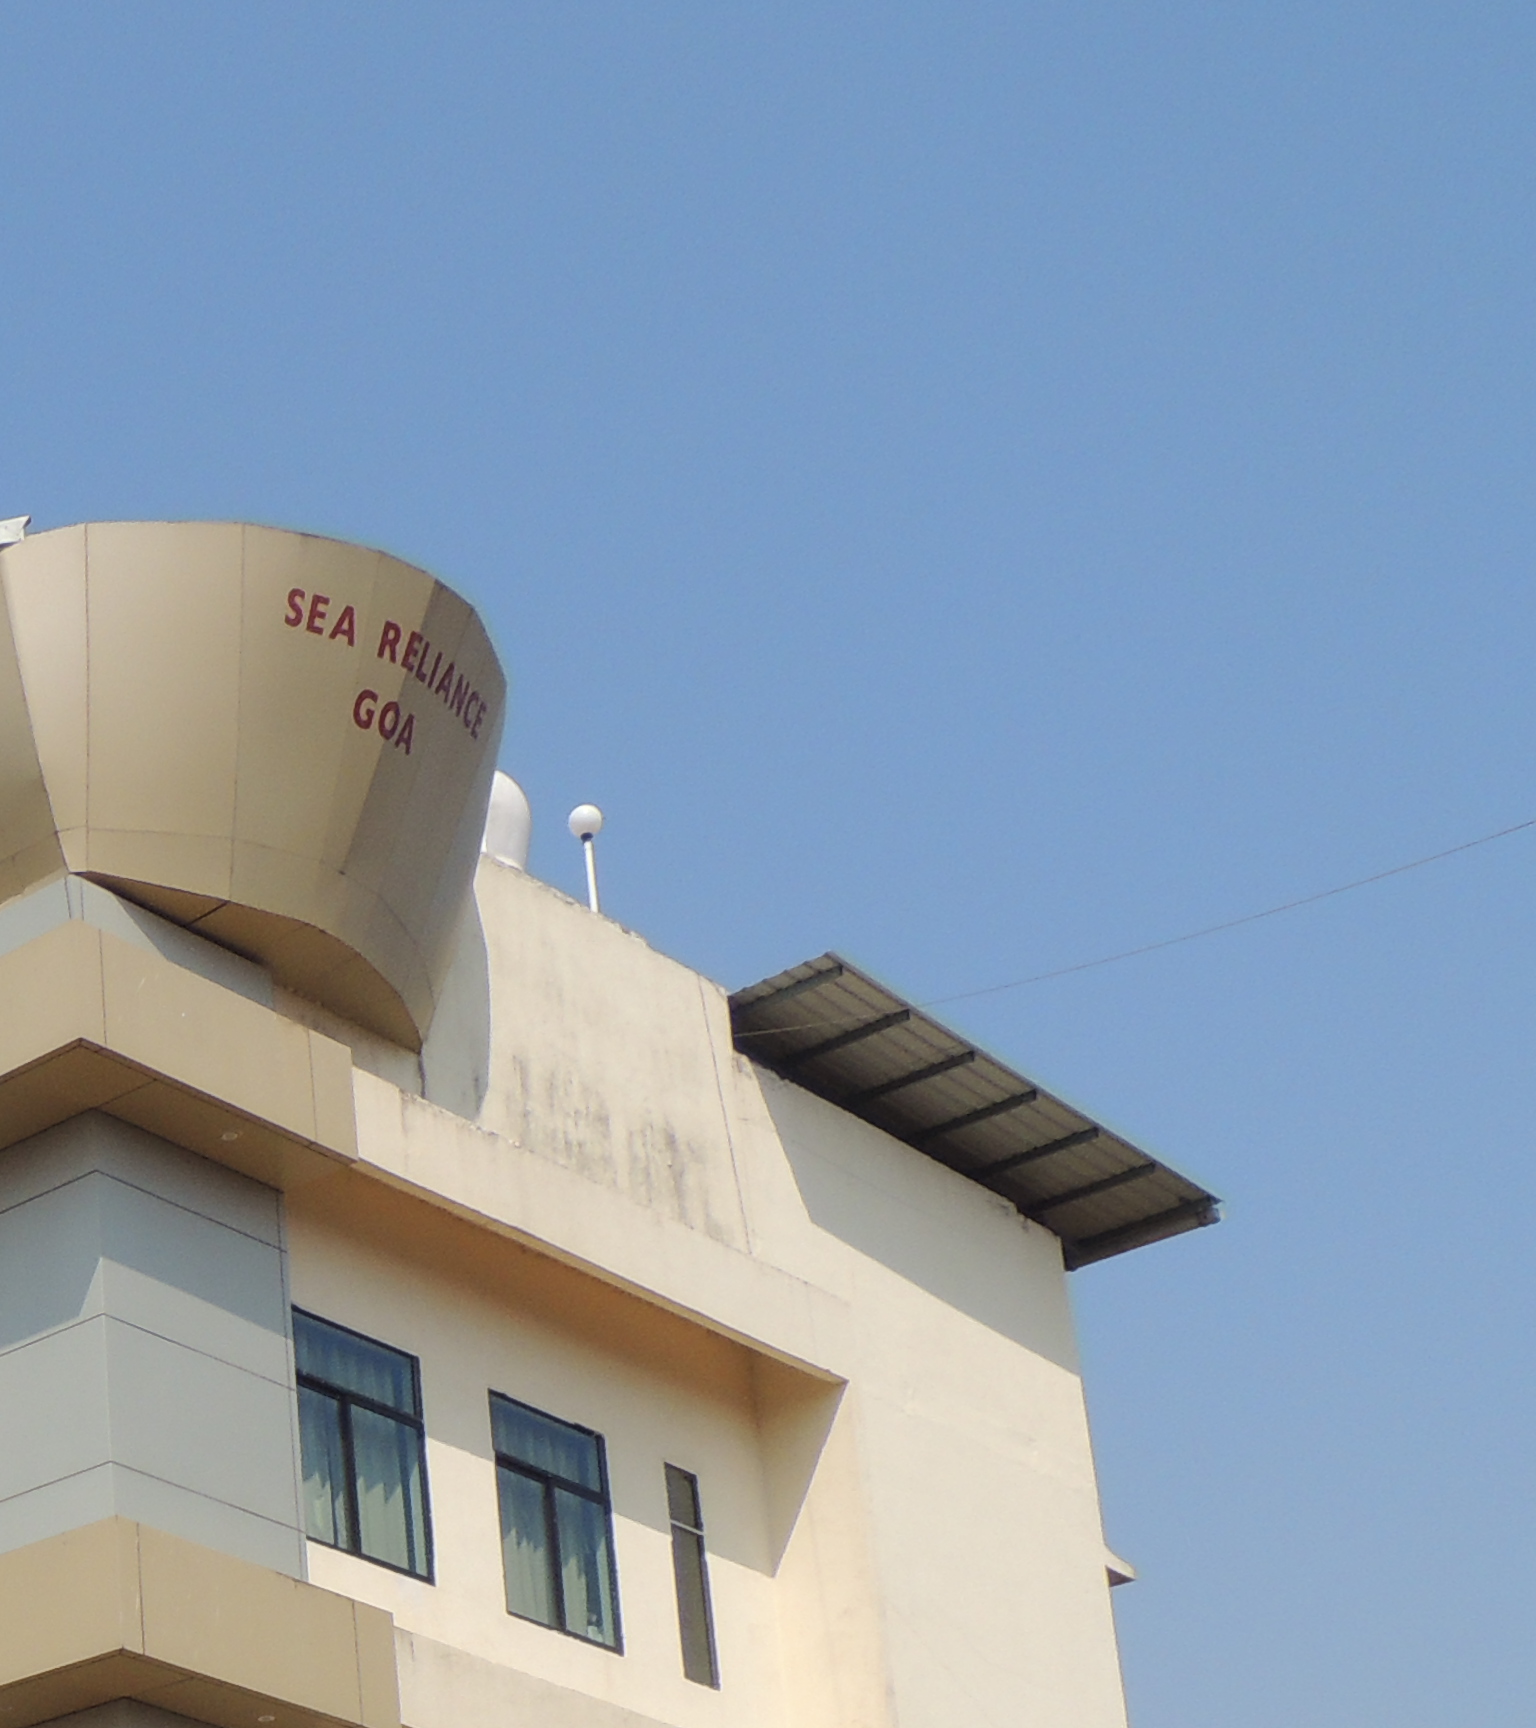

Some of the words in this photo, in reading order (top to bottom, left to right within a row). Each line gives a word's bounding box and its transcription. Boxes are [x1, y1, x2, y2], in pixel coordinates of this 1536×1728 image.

[284, 587, 356, 647] SEA
[377, 620, 487, 740] RELIANCE
[353, 689, 415, 756] GOA
